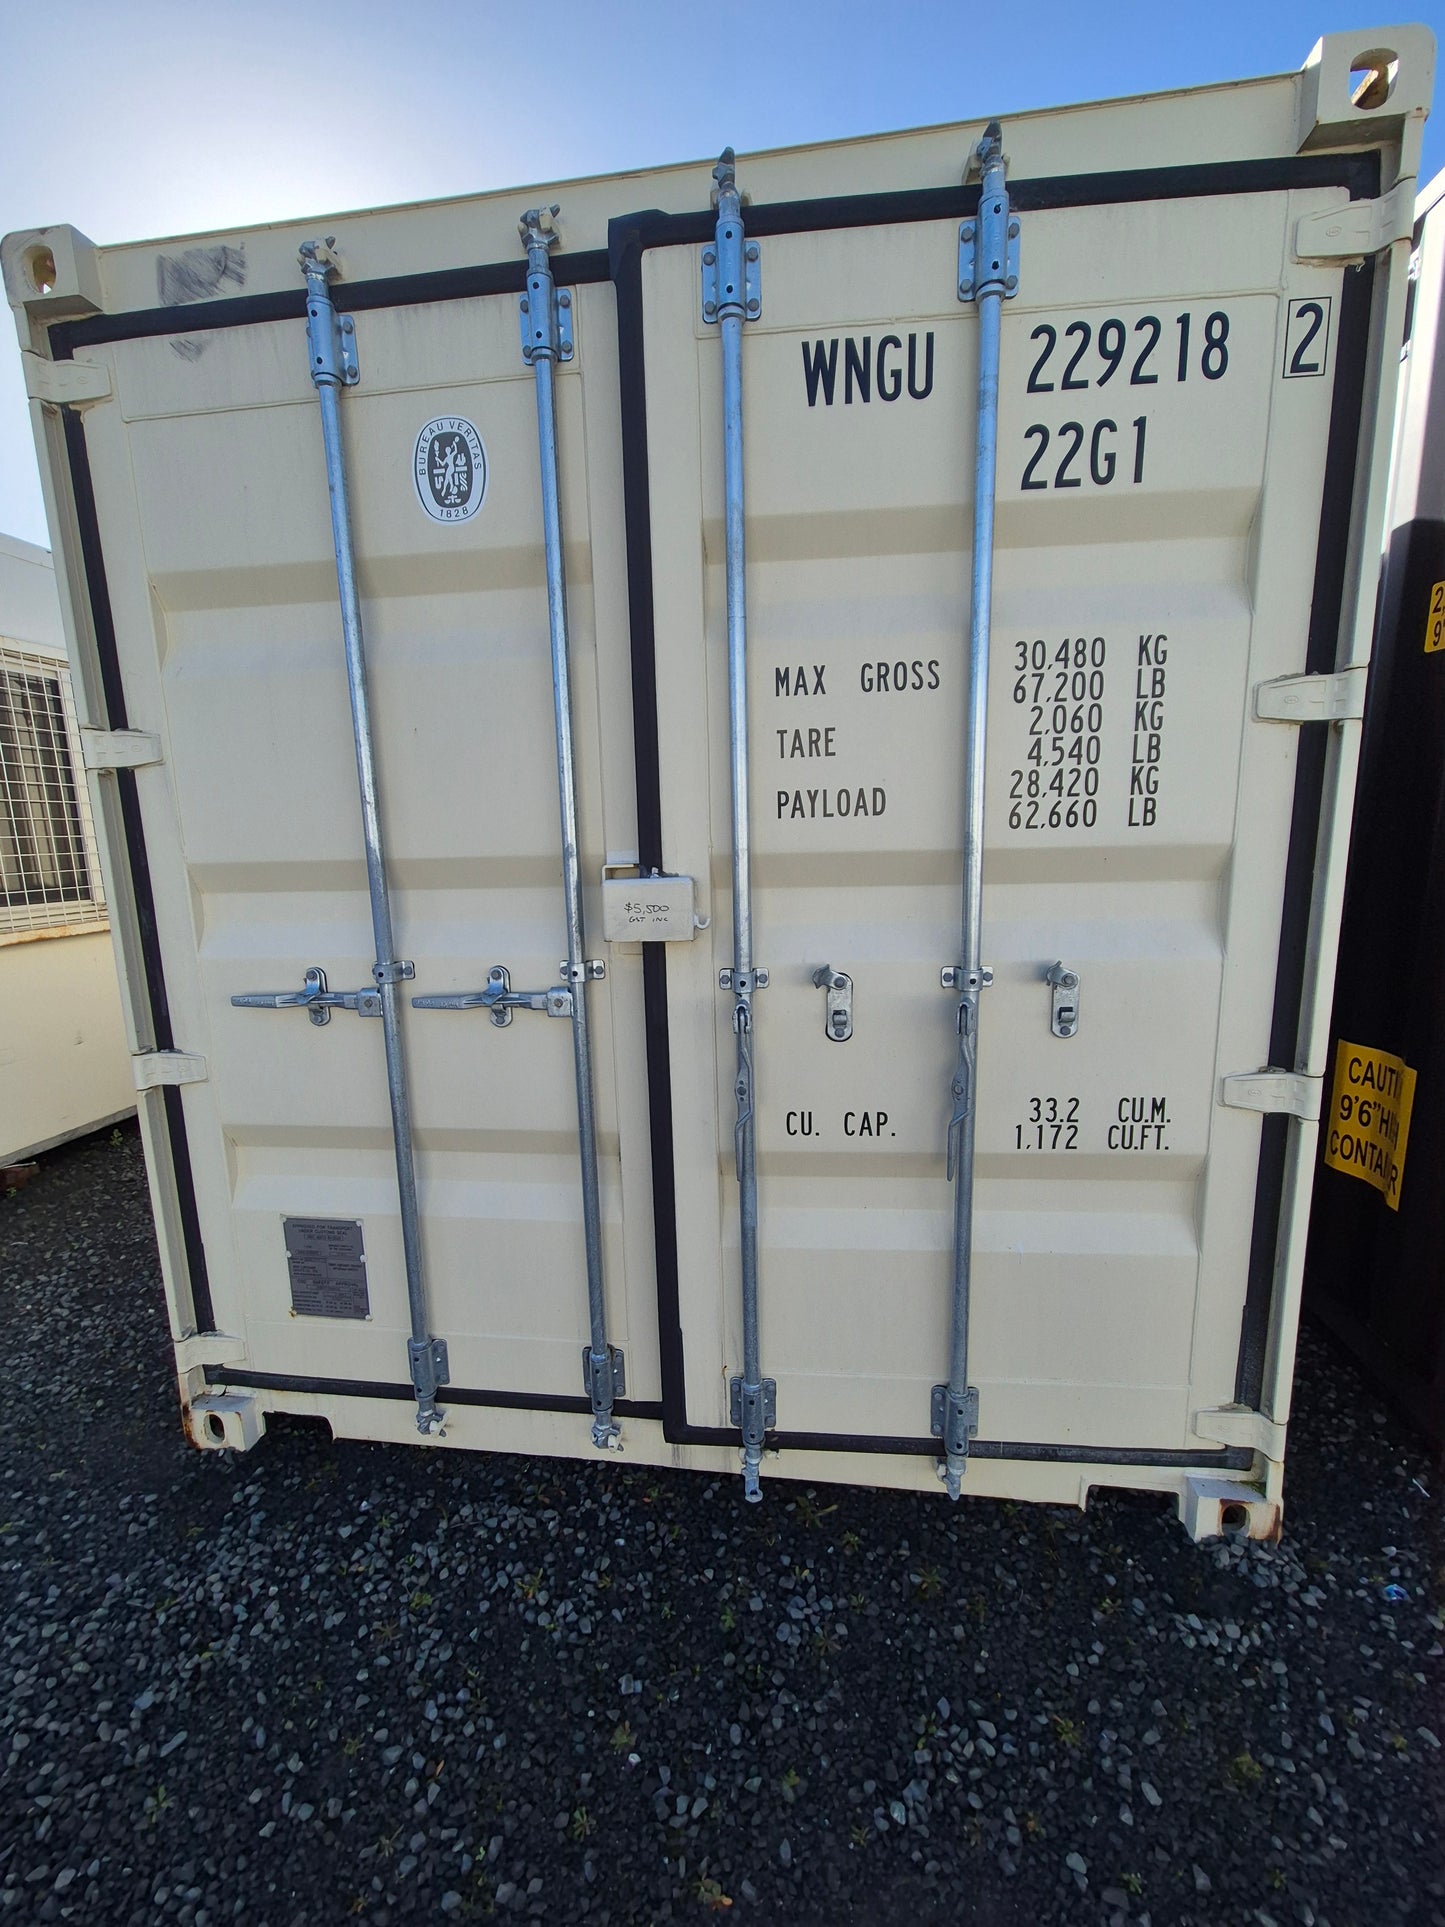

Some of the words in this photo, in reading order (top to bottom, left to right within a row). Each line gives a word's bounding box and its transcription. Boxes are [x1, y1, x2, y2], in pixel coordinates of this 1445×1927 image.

[801, 331, 935, 408] WNGU
[1026, 310, 1230, 394] 229218
[1290, 302, 1324, 374] 2
[418, 421, 444, 476] BUREAU
[448, 420, 482, 470] VERITAS
[1020, 415, 1147, 491] 22G1
[439, 506, 469, 518] 1828
[1014, 637, 1106, 672] 30,480
[1137, 634, 1168, 667] KG
[775, 666, 827, 696] MAX
[860, 660, 940, 693] GROSS
[1013, 669, 1105, 704] 67,200
[1136, 667, 1166, 699] LB
[1029, 702, 1103, 736] 2,060
[1134, 700, 1164, 732] KG
[776, 727, 836, 759] TARE
[1027, 735, 1101, 767] 4,540
[1132, 733, 1161, 764] LB
[1009, 767, 1099, 799] 28,420
[1130, 765, 1160, 796] KG
[777, 787, 887, 820] PAYLOAD
[1008, 798, 1097, 830] 62,660
[1127, 797, 1157, 827] LB
[624, 902, 670, 915] $5,500
[1348, 1057, 1401, 1099] CAUTI
[785, 1111, 820, 1137] CU.
[843, 1111, 896, 1137] CAP.
[1028, 1097, 1080, 1123] 33.2
[1117, 1096, 1172, 1124] CU.M.
[1015, 1124, 1079, 1150] 1,172
[1107, 1124, 1170, 1151] CU.FT.
[1330, 1129, 1399, 1196] CONTAIR
